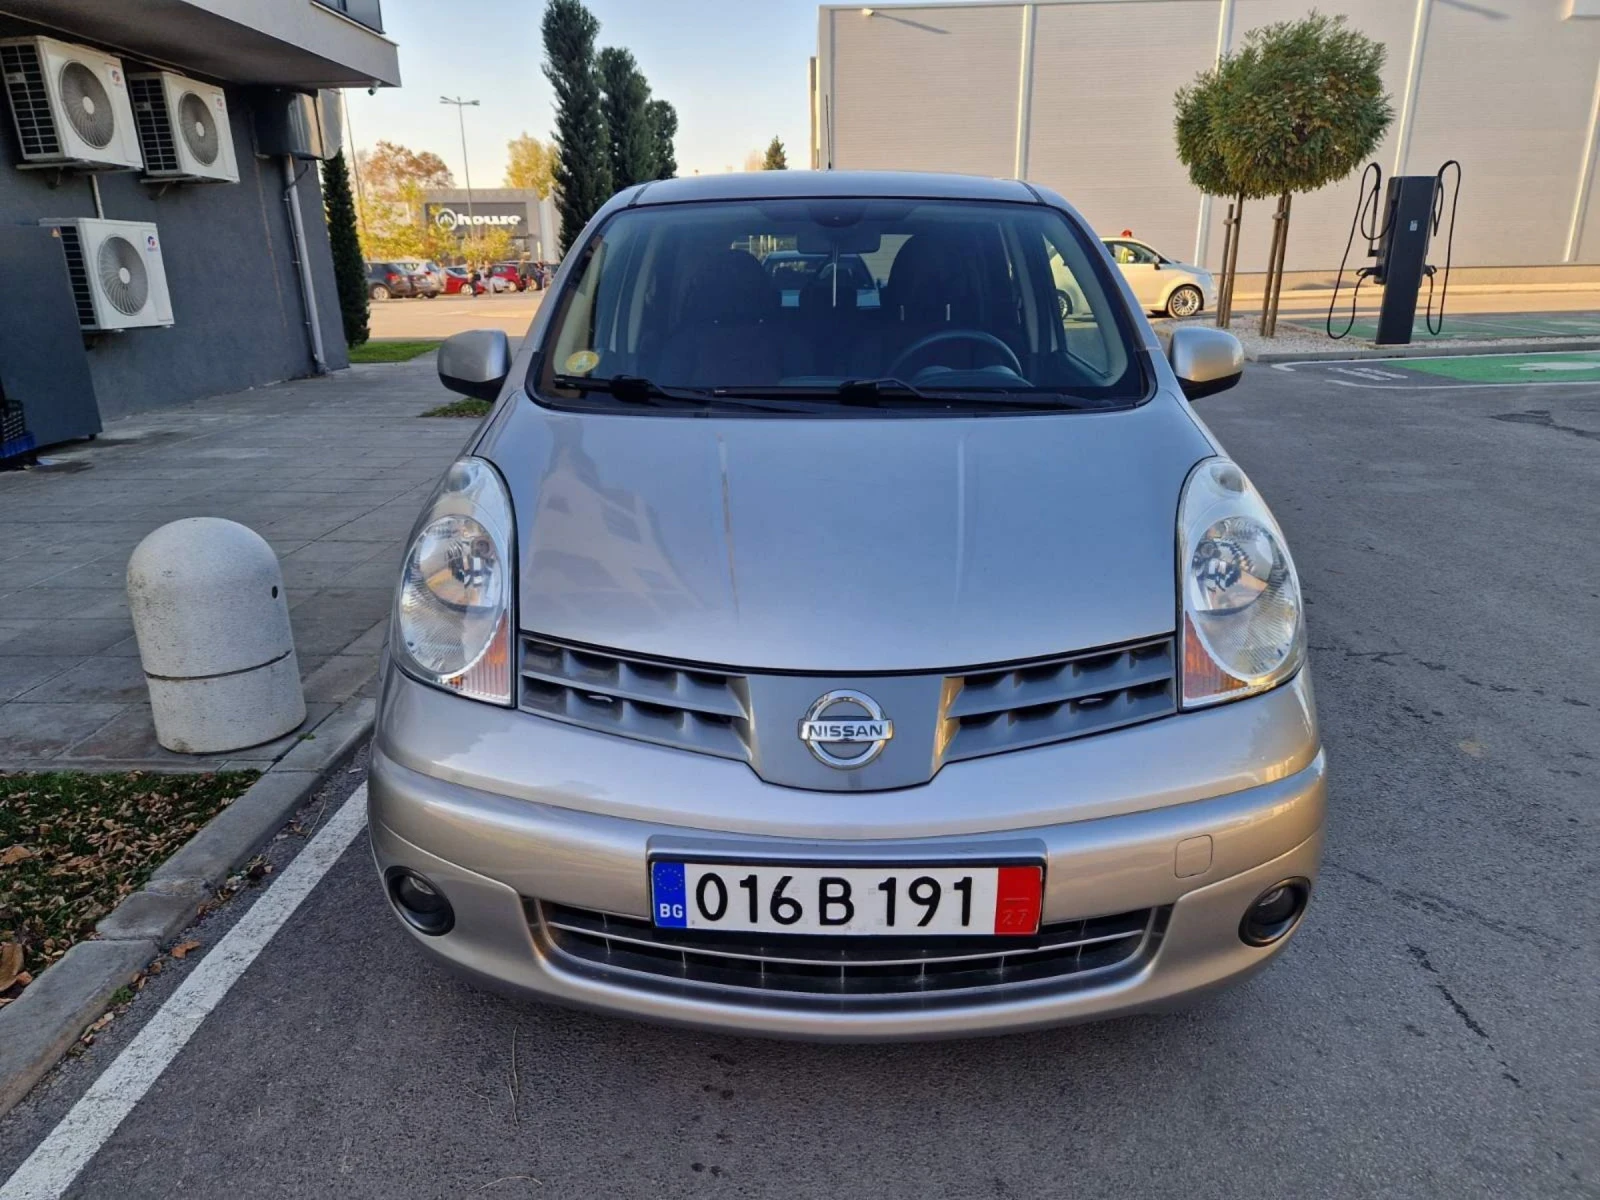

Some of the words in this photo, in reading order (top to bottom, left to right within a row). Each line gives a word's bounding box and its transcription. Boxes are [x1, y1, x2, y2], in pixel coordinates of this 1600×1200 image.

[457, 213, 521, 225] house
[809, 725, 883, 737] NISSAN
[660, 903, 683, 918] BG
